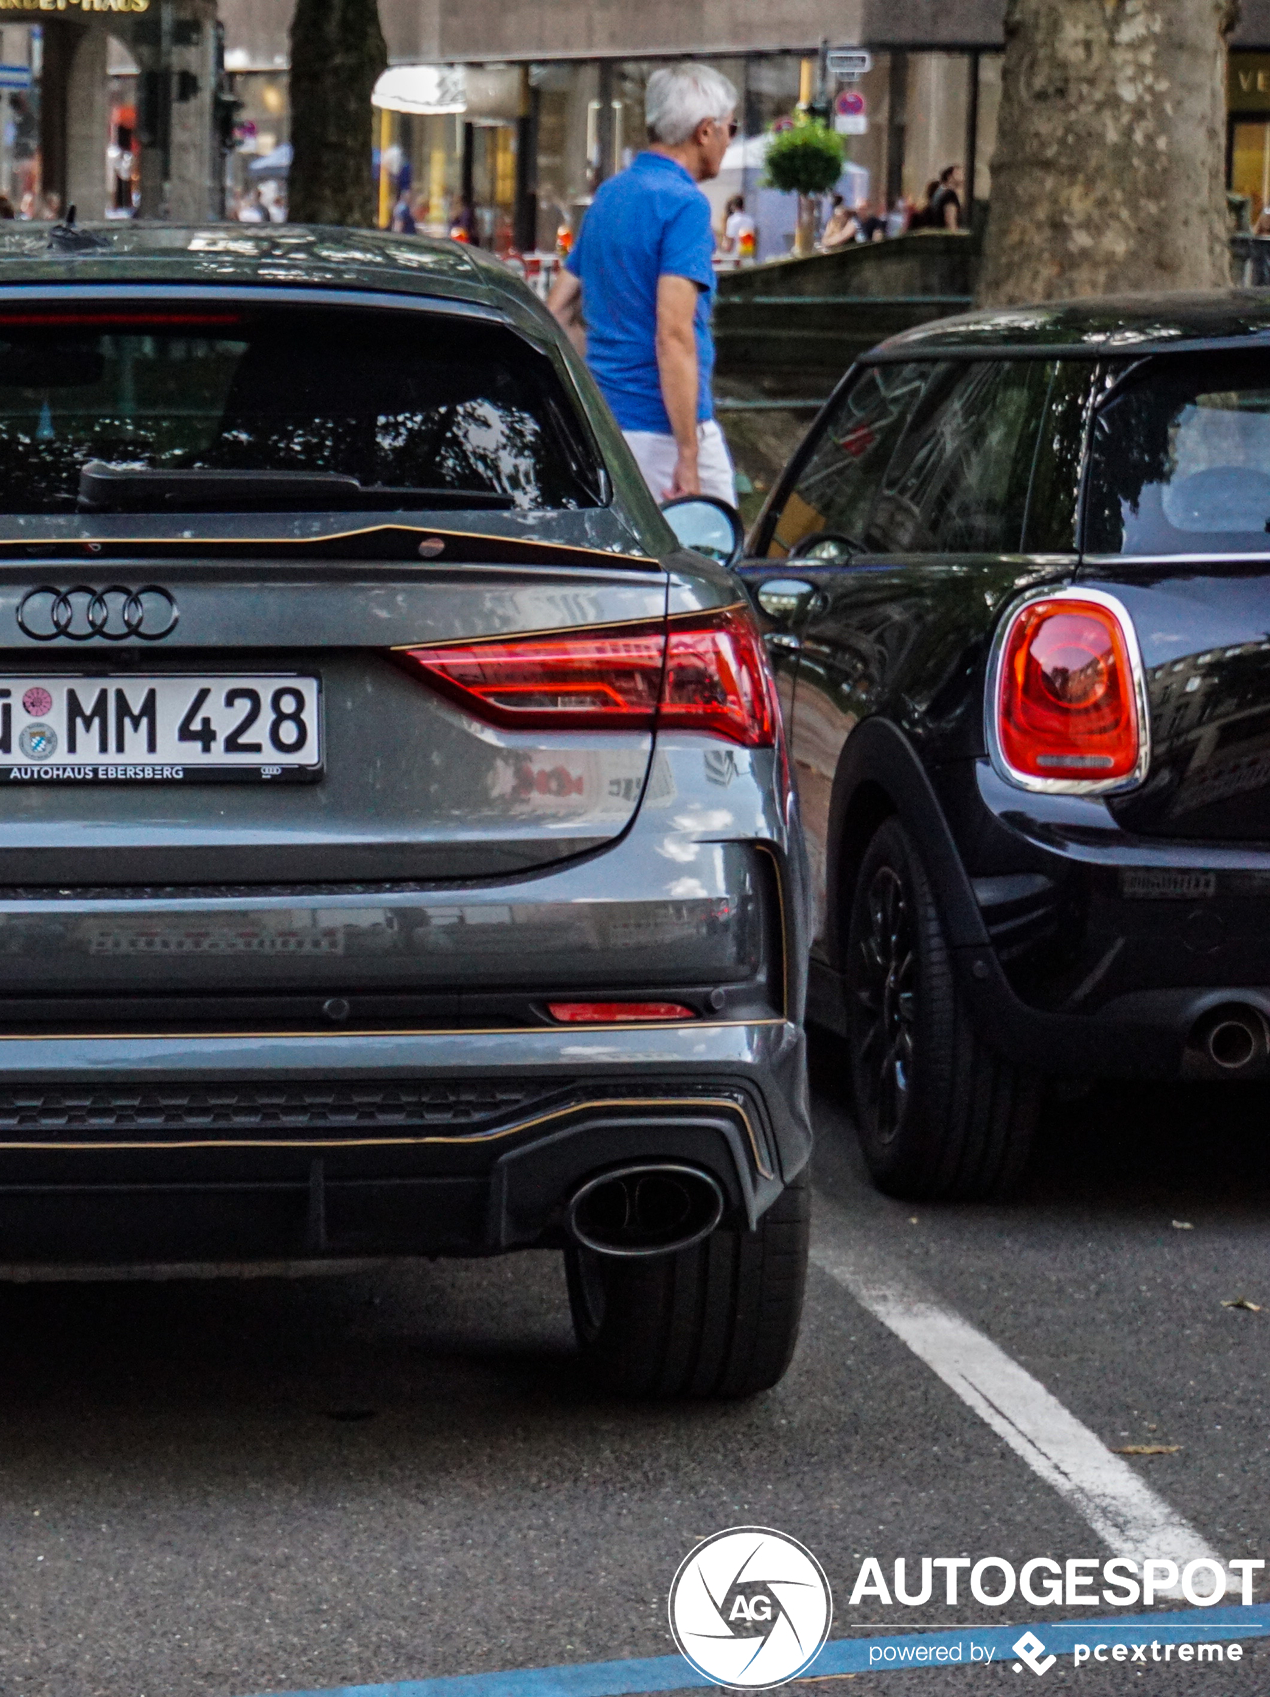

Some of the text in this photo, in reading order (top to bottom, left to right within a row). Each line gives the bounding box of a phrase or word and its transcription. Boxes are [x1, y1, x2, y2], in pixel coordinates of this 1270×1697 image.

[66, 688, 157, 754] MM
[177, 686, 308, 754] 428
[10, 767, 184, 780] AUTOHAUS EBERSBERG
